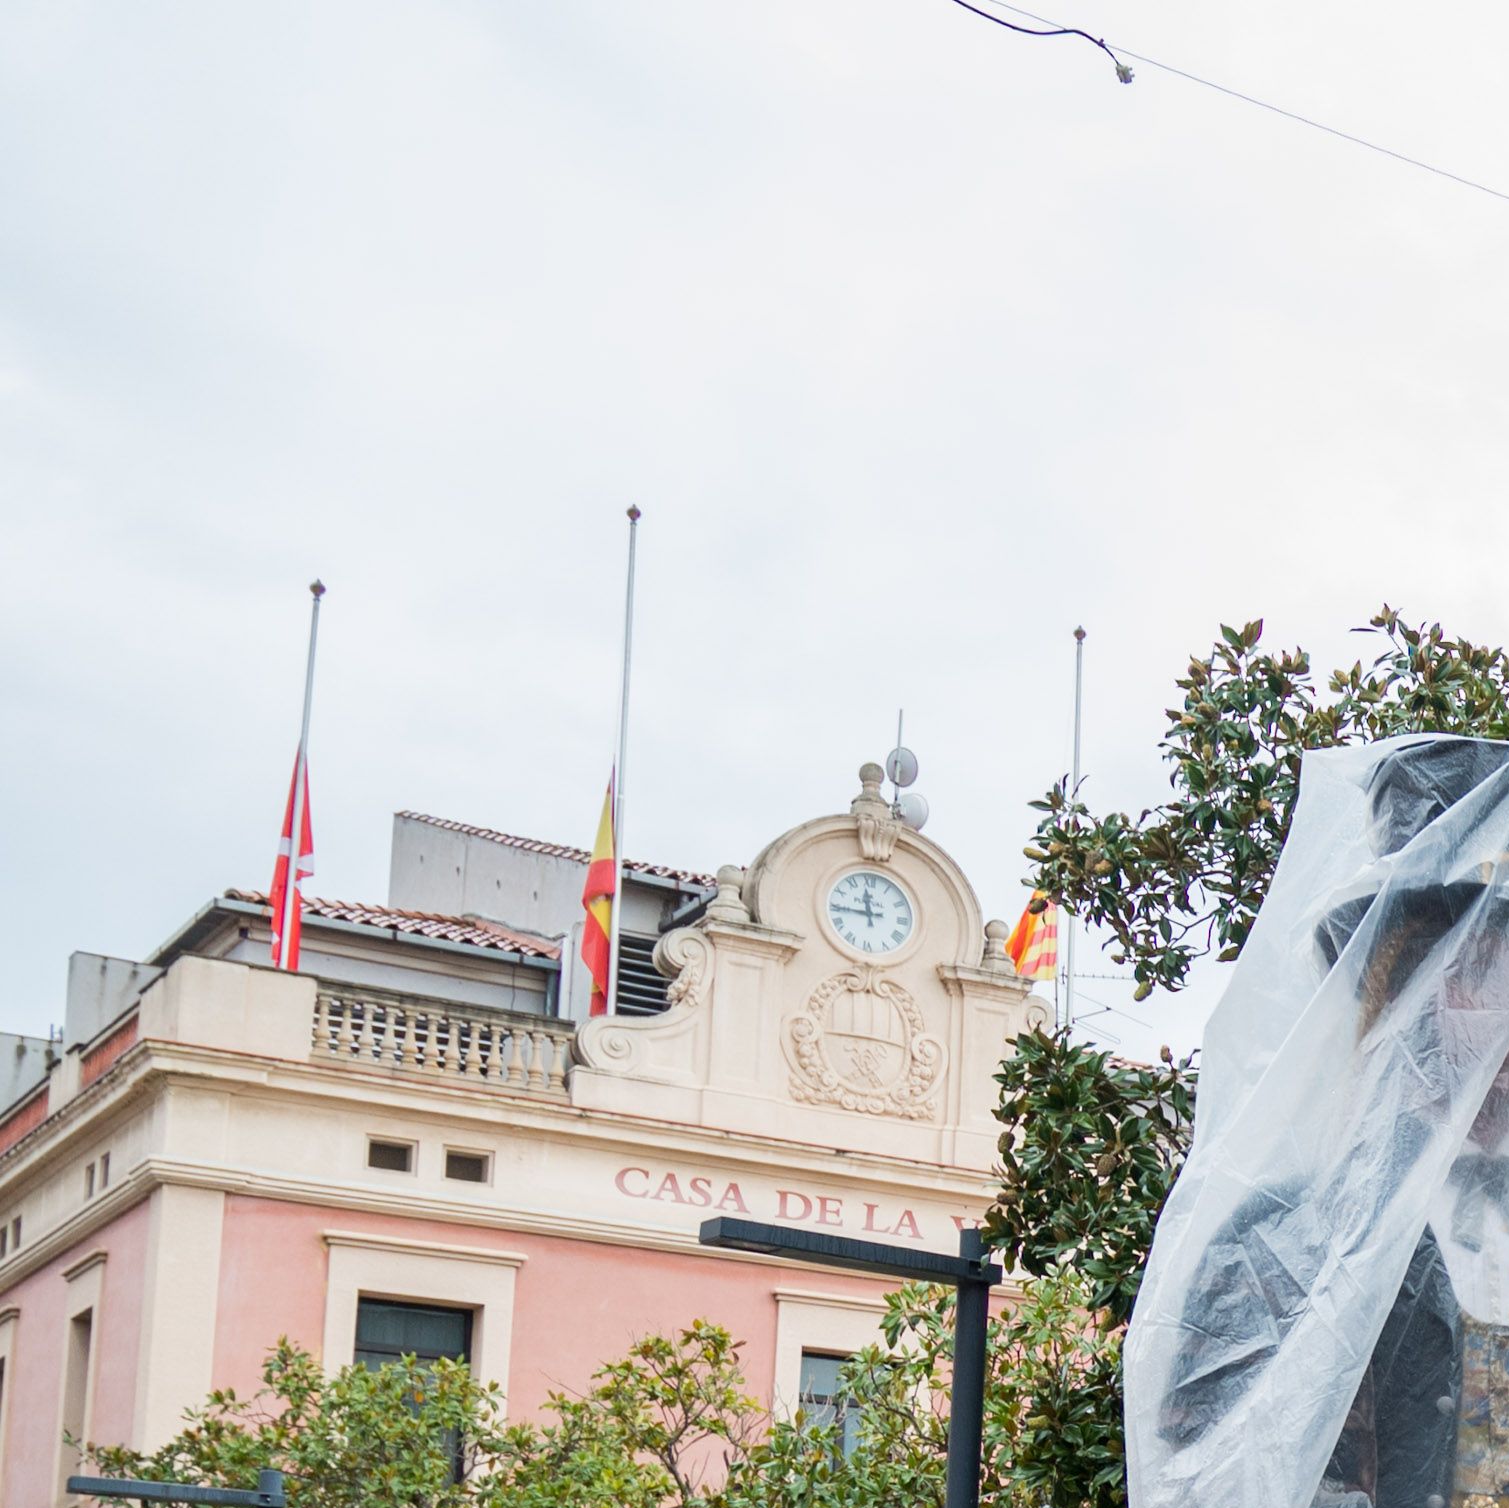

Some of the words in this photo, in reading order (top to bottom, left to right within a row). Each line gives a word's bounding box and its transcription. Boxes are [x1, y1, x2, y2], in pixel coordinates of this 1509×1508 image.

[614, 1166, 751, 1215] CASA
[775, 1189, 844, 1228] DE
[863, 1203, 924, 1240] LA
